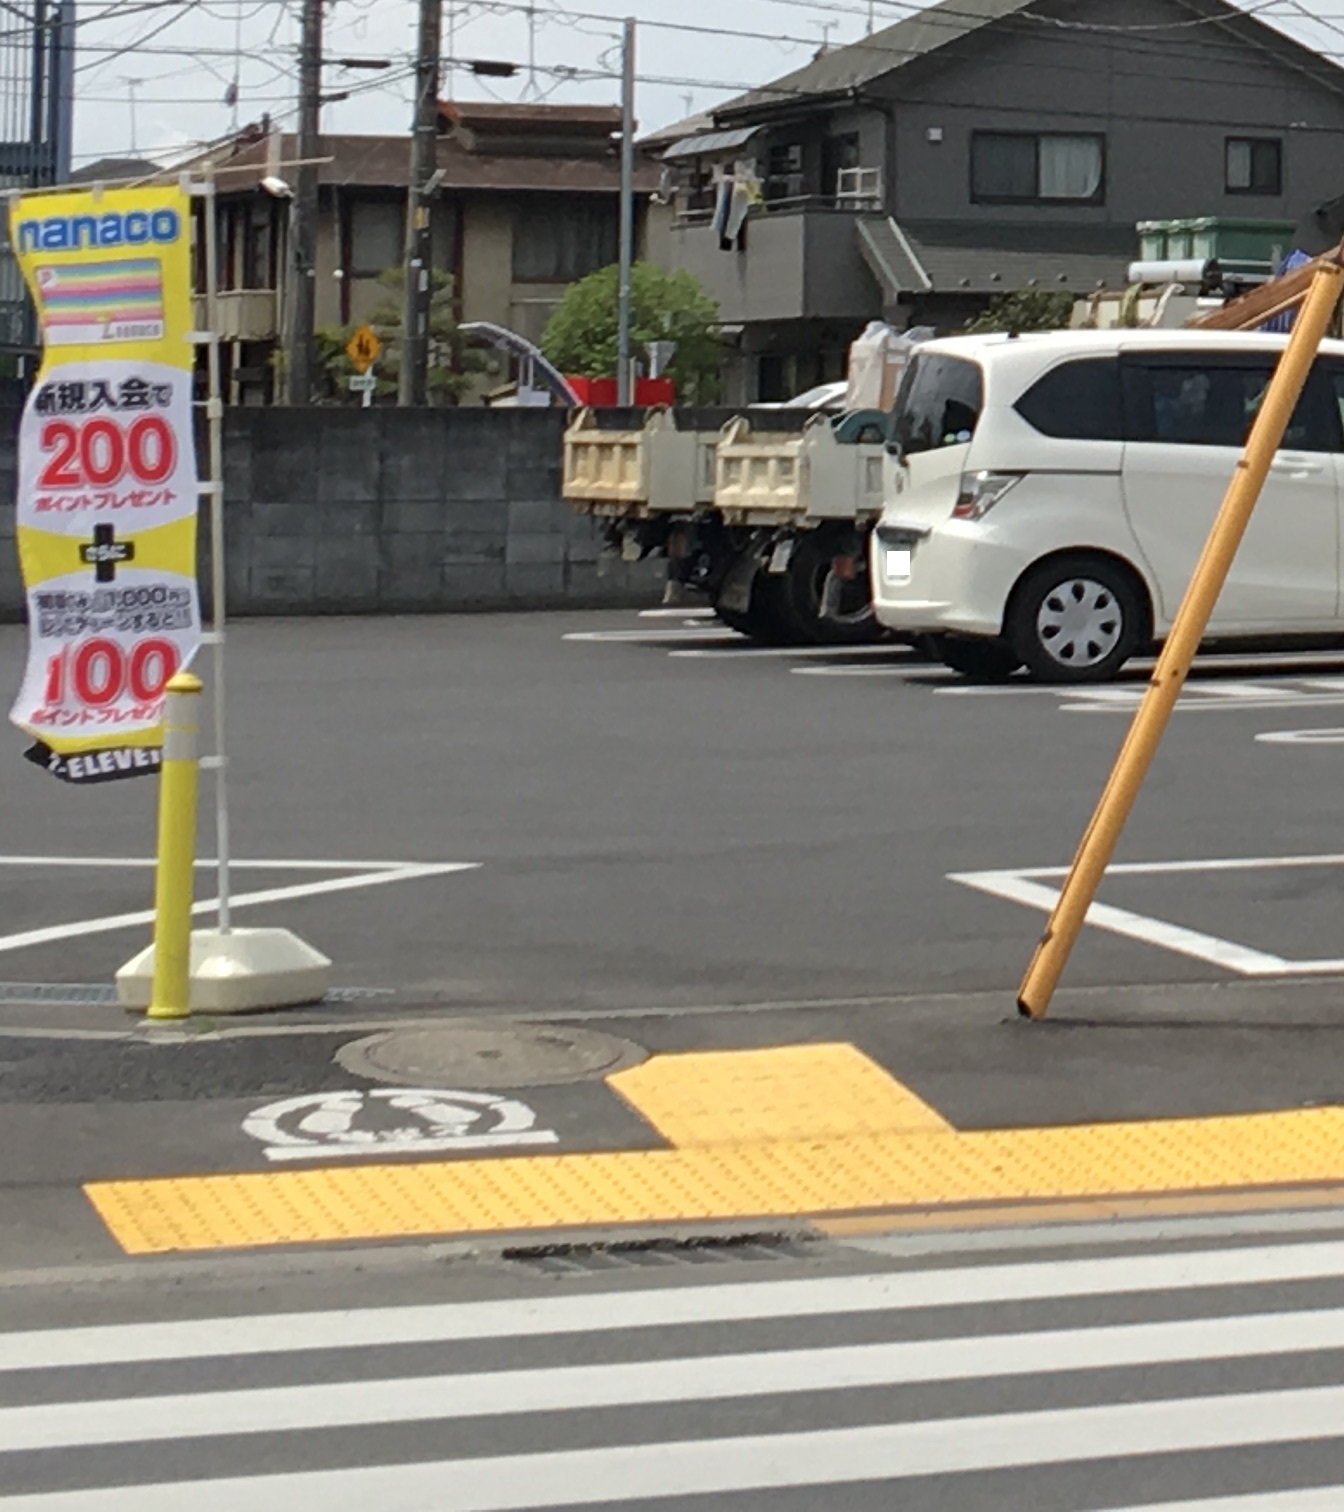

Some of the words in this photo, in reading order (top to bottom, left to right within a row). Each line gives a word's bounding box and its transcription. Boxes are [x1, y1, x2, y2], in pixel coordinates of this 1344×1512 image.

[19, 210, 179, 255] nanaco
[35, 376, 173, 414] 新規入会で
[39, 415, 178, 490] 200
[34, 489, 177, 512] ポイントプレゼント
[46, 636, 180, 706] 100
[29, 701, 166, 726] ポイントプレゼン
